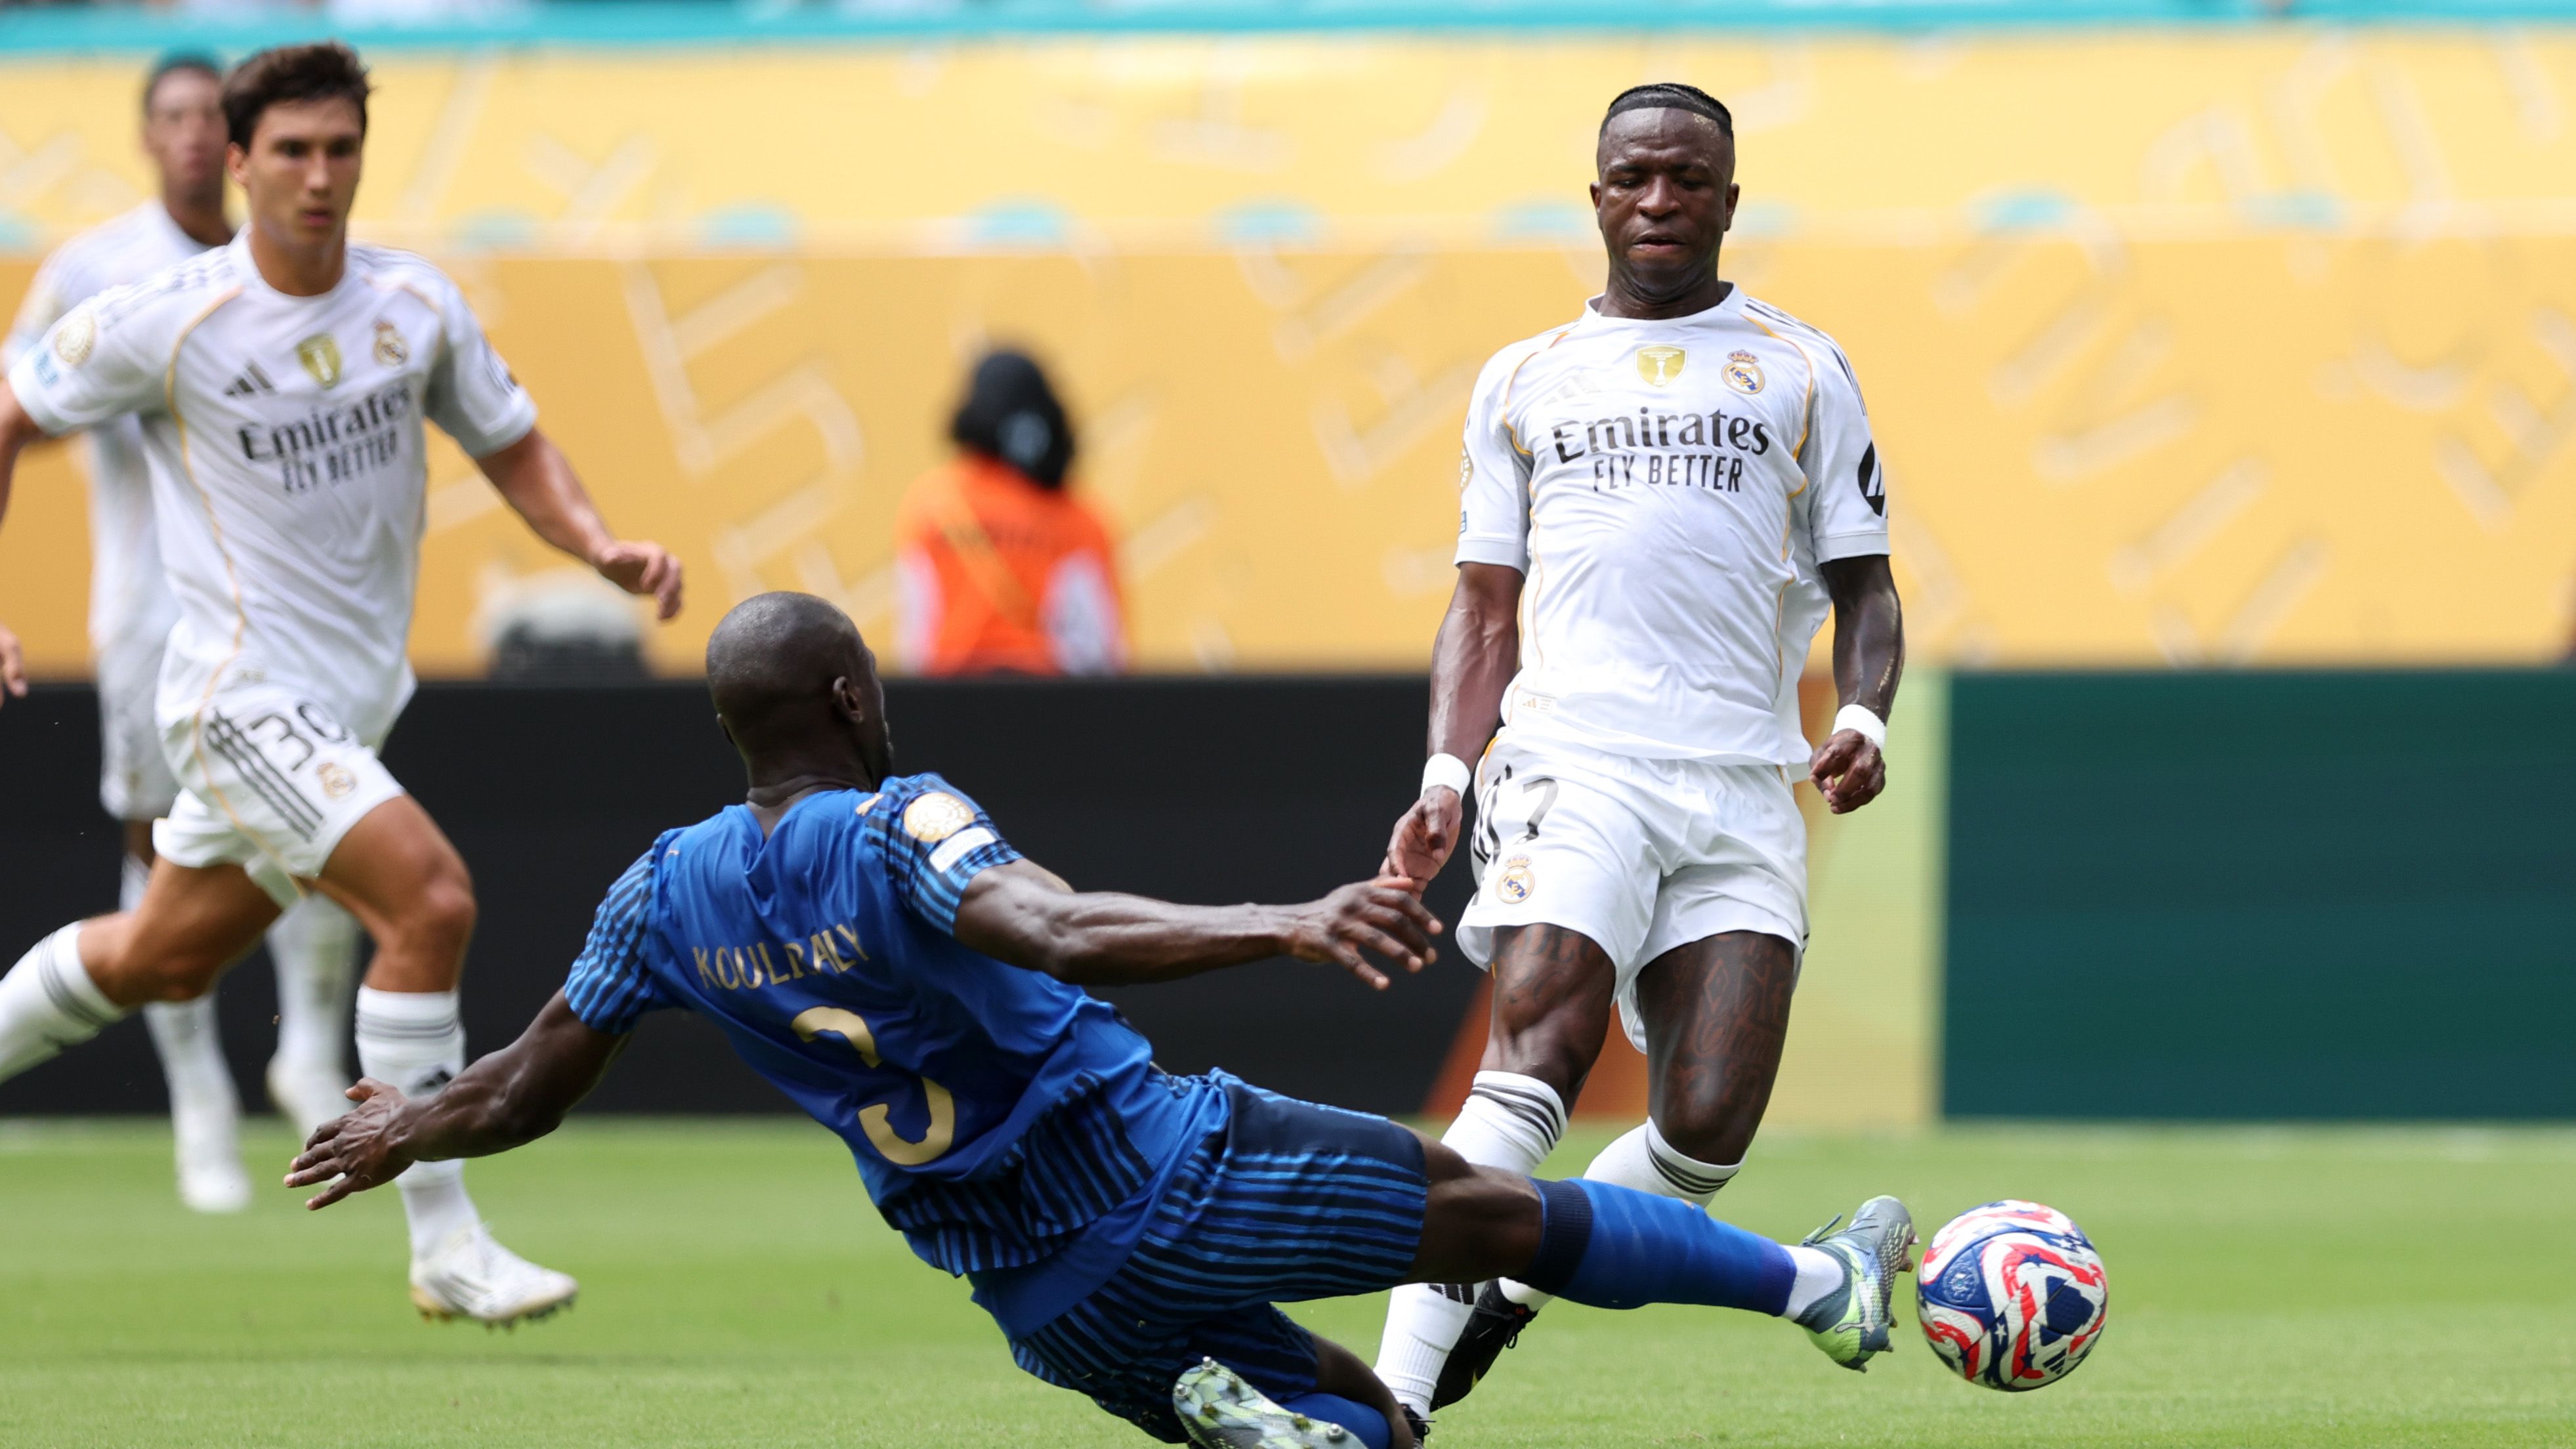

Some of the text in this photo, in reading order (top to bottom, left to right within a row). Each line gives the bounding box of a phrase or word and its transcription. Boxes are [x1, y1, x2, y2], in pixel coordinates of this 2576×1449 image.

[1552, 406, 1770, 464] Emirates
[1593, 453, 1743, 493] FLY BETTER
[249, 700, 348, 772] 30
[792, 1005, 956, 1166] 3
